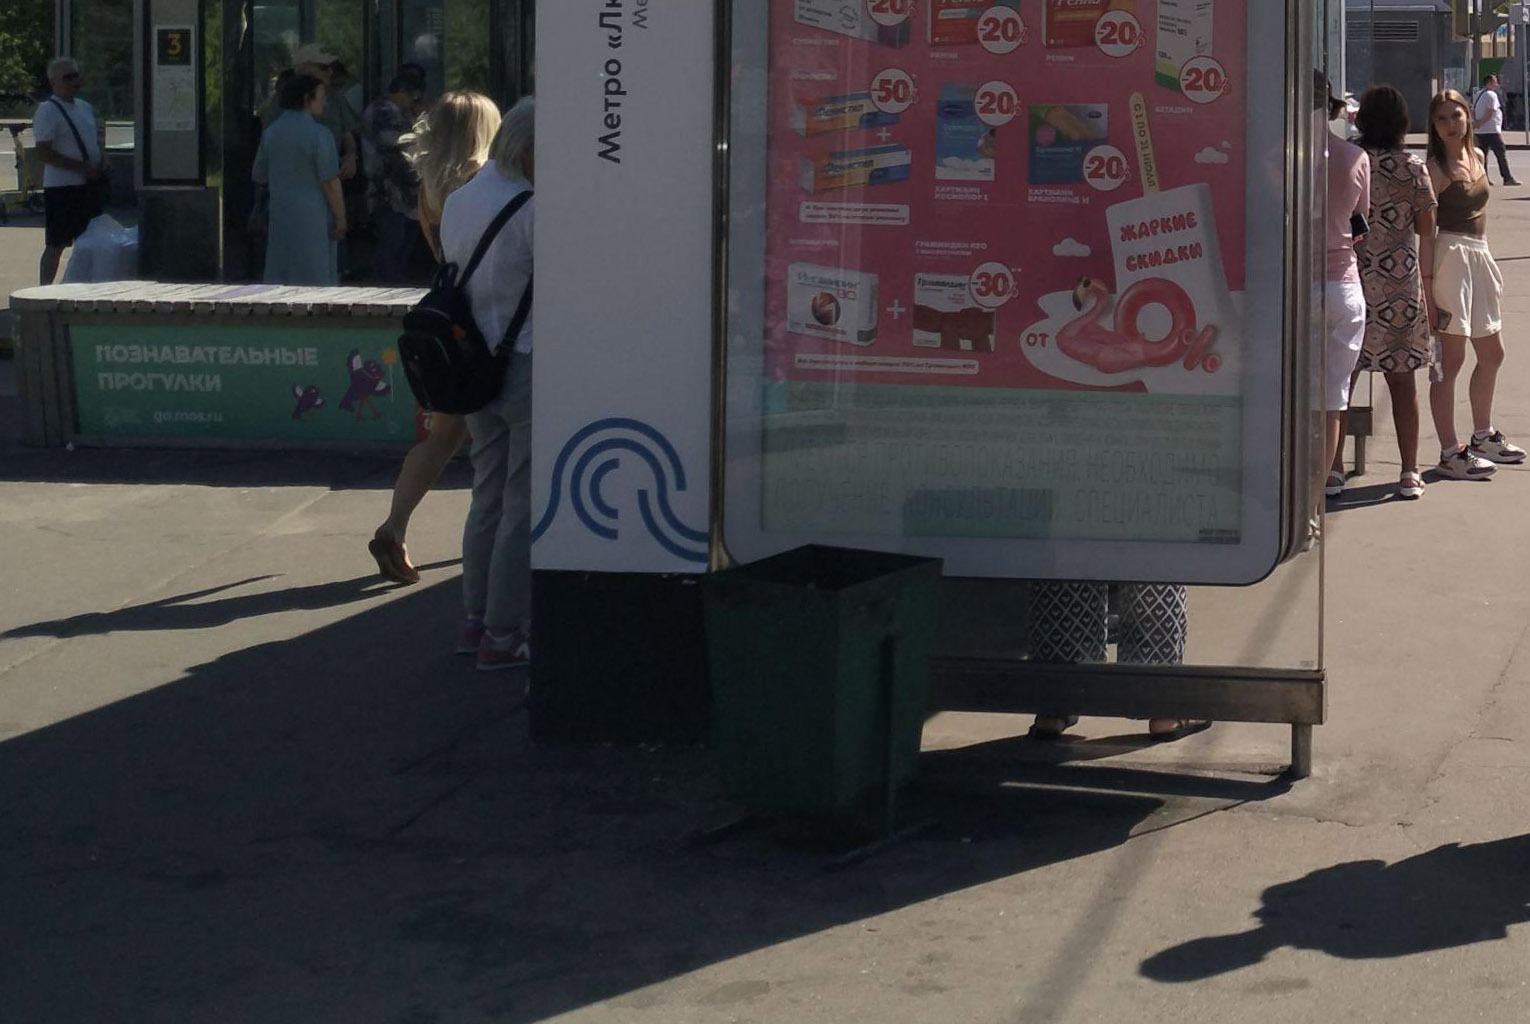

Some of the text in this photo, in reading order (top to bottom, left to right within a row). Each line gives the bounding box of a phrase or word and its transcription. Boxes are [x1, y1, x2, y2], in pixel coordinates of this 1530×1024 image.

[597, 57, 627, 165] Метро
[1120, 211, 1198, 242] ЖАРКИЕ
[1125, 242, 1203, 272] СКИДКИ
[95, 344, 319, 366] ПОЗНАВАТЕЛЬНЫЕ
[97, 372, 222, 393] ПРОГУЛКИ
[153, 409, 224, 423] go.mos.ru
